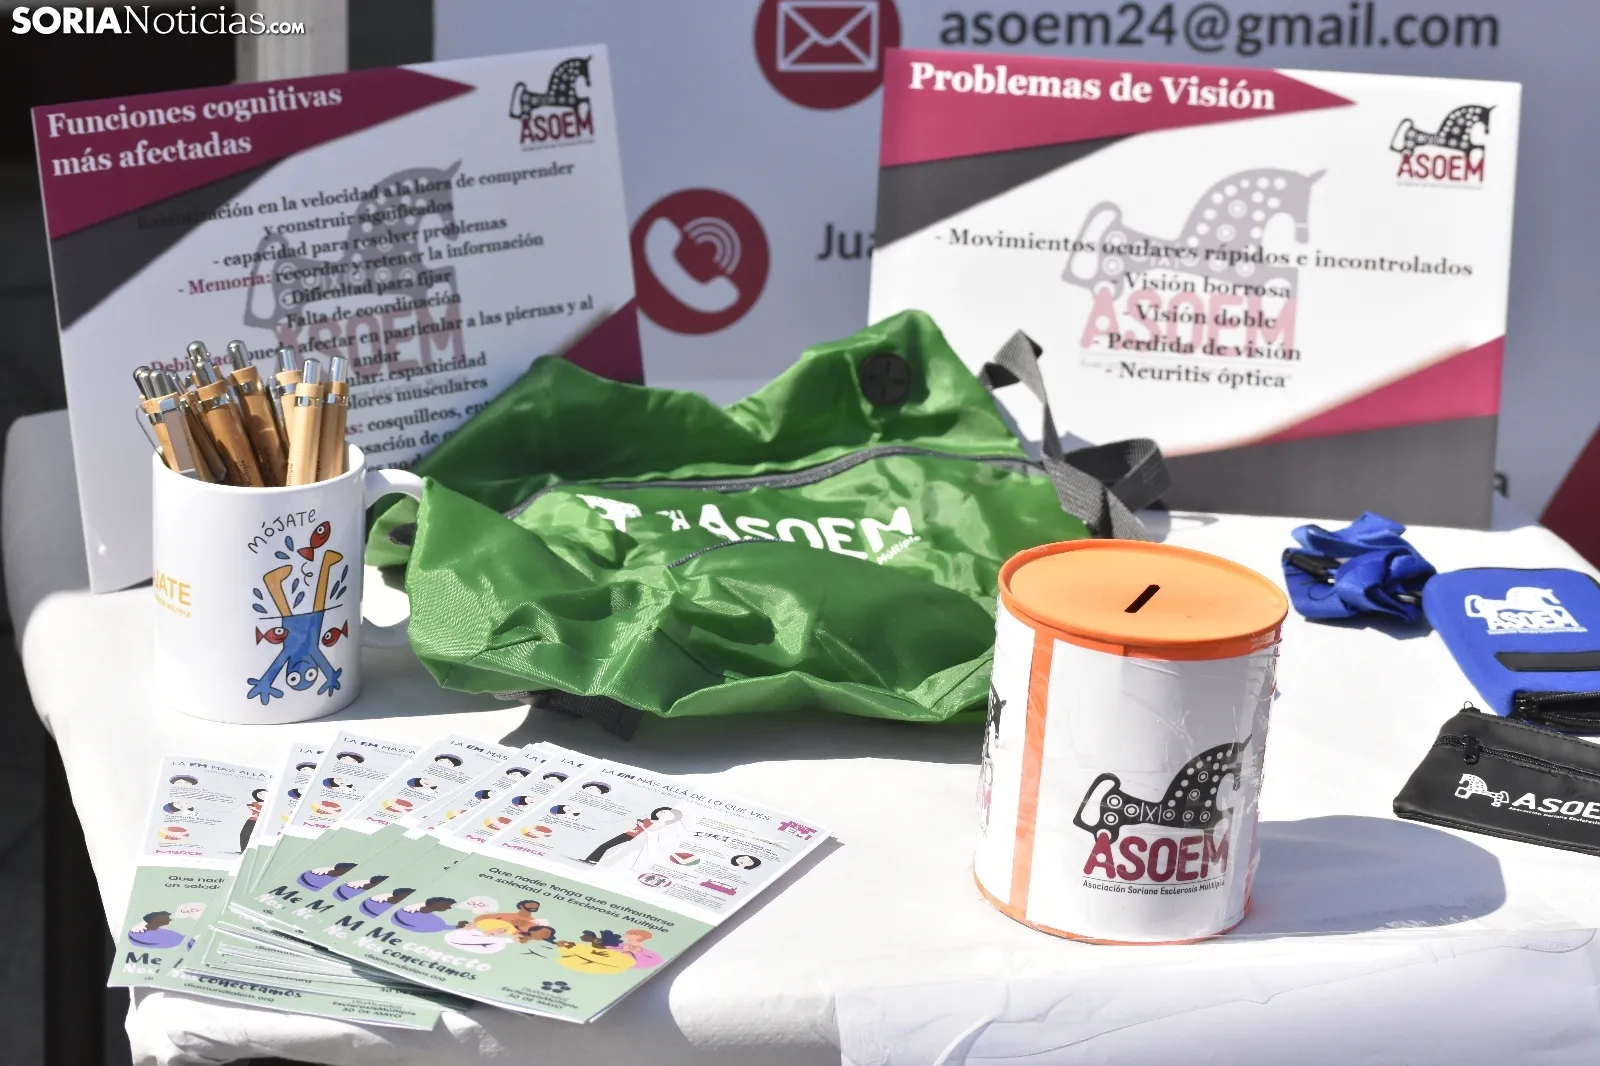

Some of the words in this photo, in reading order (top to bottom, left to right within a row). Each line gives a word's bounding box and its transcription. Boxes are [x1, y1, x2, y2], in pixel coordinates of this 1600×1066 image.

[939, 2, 1499, 58] asoem24@gmail.com
[909, 61, 1102, 100] Problemas
[1110, 72, 1152, 103] de
[1159, 76, 1275, 111] Visión
[47, 104, 197, 138] Funciones
[203, 86, 343, 122] cognitivas
[520, 110, 594, 144] ASOEM
[52, 147, 112, 177] más
[119, 131, 252, 168] afectadas
[1397, 153, 1485, 183] ASOEM
[259, 202, 278, 214] en
[282, 196, 298, 212] la
[300, 182, 379, 208] velocidad
[396, 181, 412, 197] la
[414, 178, 452, 194] hora
[456, 174, 475, 188] de
[479, 161, 575, 187] comprender
[264, 226, 274, 240] y
[277, 213, 354, 234] construir
[358, 199, 454, 226] significados
[223, 240, 308, 268] capacidad
[311, 241, 349, 258] para
[353, 227, 419, 249] resolver
[423, 217, 508, 242] problemas
[948, 228, 1095, 253] Movimientos
[1101, 238, 1198, 261] oculares
[1204, 243, 1290, 266] rápidos
[1296, 254, 1308, 267] e
[1314, 249, 1473, 276] incontrolados
[188, 273, 271, 295] Memoria:
[275, 259, 349, 283] recordar
[352, 262, 363, 275] y
[365, 252, 424, 270] retener
[428, 246, 443, 261] la
[447, 234, 544, 259] información
[292, 280, 373, 305] Dificultad
[376, 277, 414, 296] para
[417, 269, 451, 289] fijar
[1123, 271, 1196, 293] Visión
[1202, 276, 1292, 299] borrosa
[286, 310, 328, 328] Falta
[332, 304, 350, 320] de
[356, 291, 461, 317] coordinación
[299, 333, 355, 353] afectar
[360, 330, 379, 344] en
[383, 318, 463, 344] particular
[467, 318, 475, 327] a
[479, 311, 502, 327] las
[505, 305, 564, 326] piernas
[567, 302, 576, 316] y
[579, 295, 594, 310] al
[1136, 303, 1207, 324] Visión
[1214, 309, 1277, 329] doble
[353, 350, 401, 368] andar
[1107, 332, 1195, 355] Perdida
[1202, 339, 1228, 356] de
[1233, 340, 1302, 361] visión
[388, 351, 487, 382] espasticidad
[1119, 361, 1211, 383] Neuritis
[1218, 366, 1286, 390] óptica
[396, 377, 488, 400] musculares
[367, 406, 461, 433] cosquilleos,
[420, 429, 438, 445] de
[699, 504, 913, 560] ASOEM
[1488, 609, 1581, 630] ASOEM
[1083, 831, 1229, 882] ASOEM
[168, 875, 194, 883] Que
[268, 885, 302, 904] Me
[1082, 879, 1125, 894] Asociación
[1127, 886, 1158, 895] Soriana
[1160, 884, 1198, 895] Esclerosis
[478, 872, 493, 881] en
[495, 875, 542, 894] soledad
[553, 892, 565, 901] la
[567, 897, 621, 918] Esclerosis
[622, 914, 670, 934] Múltiple
[488, 867, 512, 878] Que
[515, 873, 547, 888] nadie
[549, 883, 583, 899] tenga
[585, 894, 608, 907] que
[609, 900, 675, 927] enfrentarse
[125, 951, 163, 965] Me
[365, 926, 402, 946] Me
[402, 942, 492, 972] conecto
[382, 947, 477, 980] conectamos
